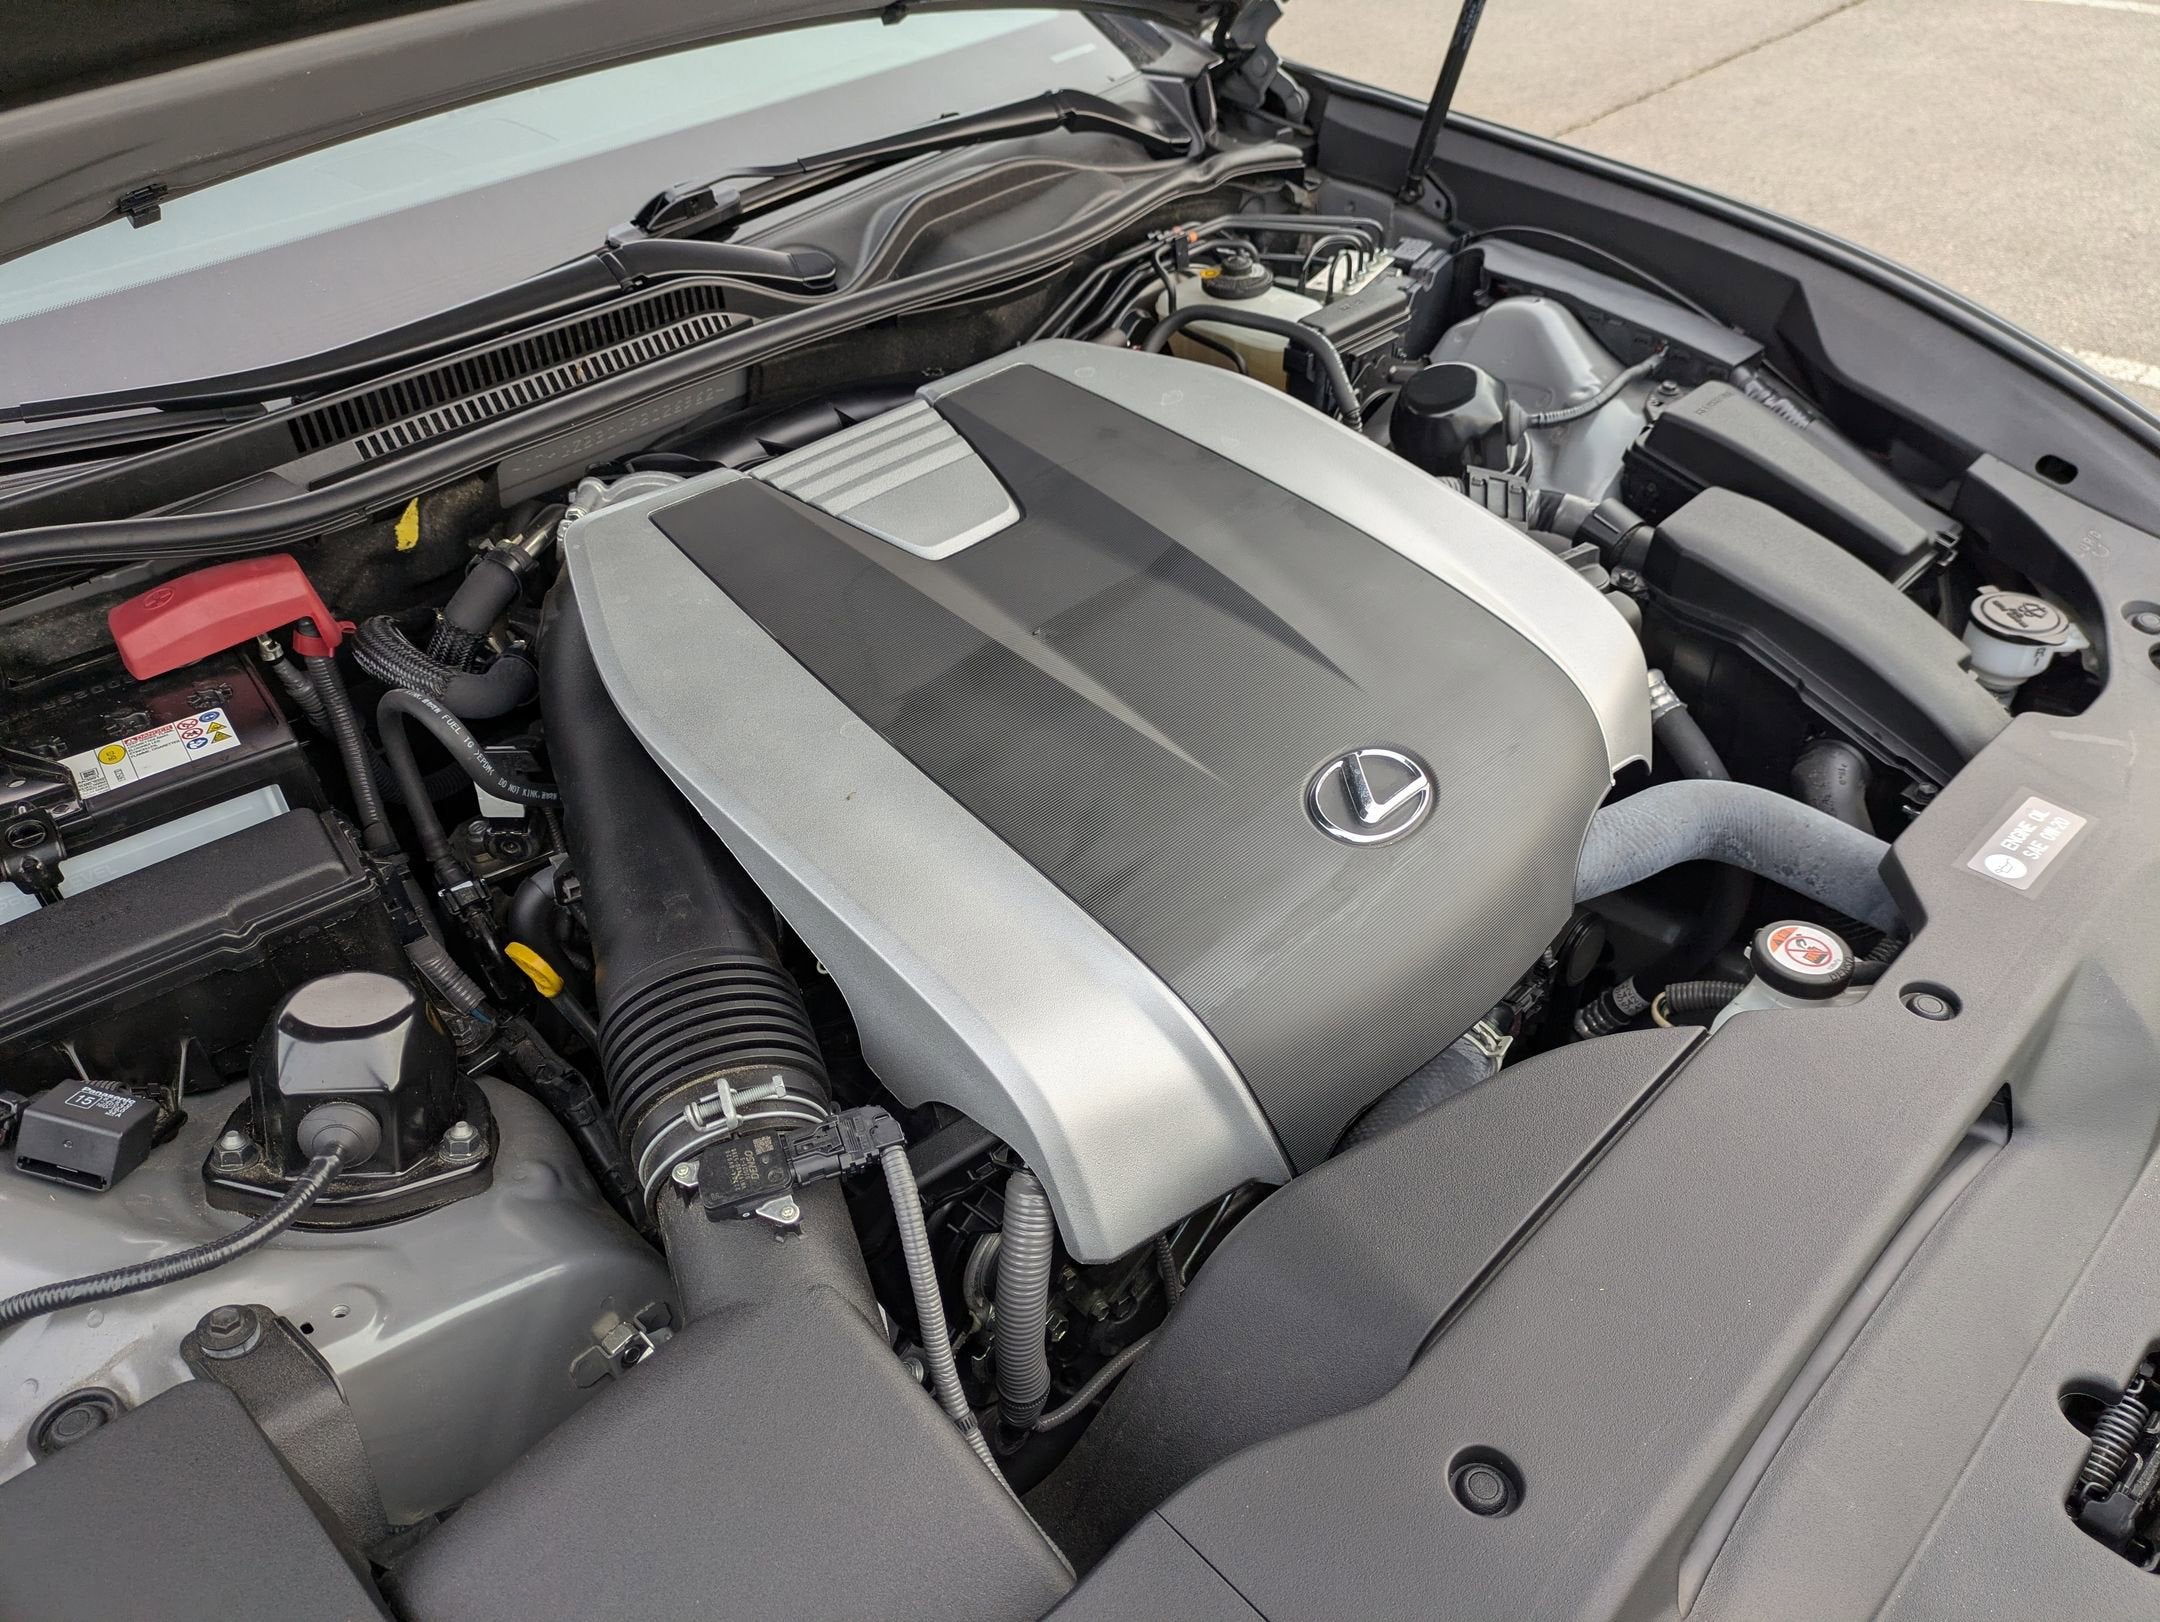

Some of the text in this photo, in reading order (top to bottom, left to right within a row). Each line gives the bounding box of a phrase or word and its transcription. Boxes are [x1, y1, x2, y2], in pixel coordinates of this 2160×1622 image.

[441, 714, 461, 735] FUEL
[497, 777, 507, 789] DO
[507, 784, 520, 796] NOT
[2000, 820, 2038, 851] ENGINE
[2022, 840, 2049, 860] SAE
[75, 1095, 95, 1105] 15
[81, 1086, 136, 1104] Panasonic
[744, 1150, 760, 1180] DENSO
